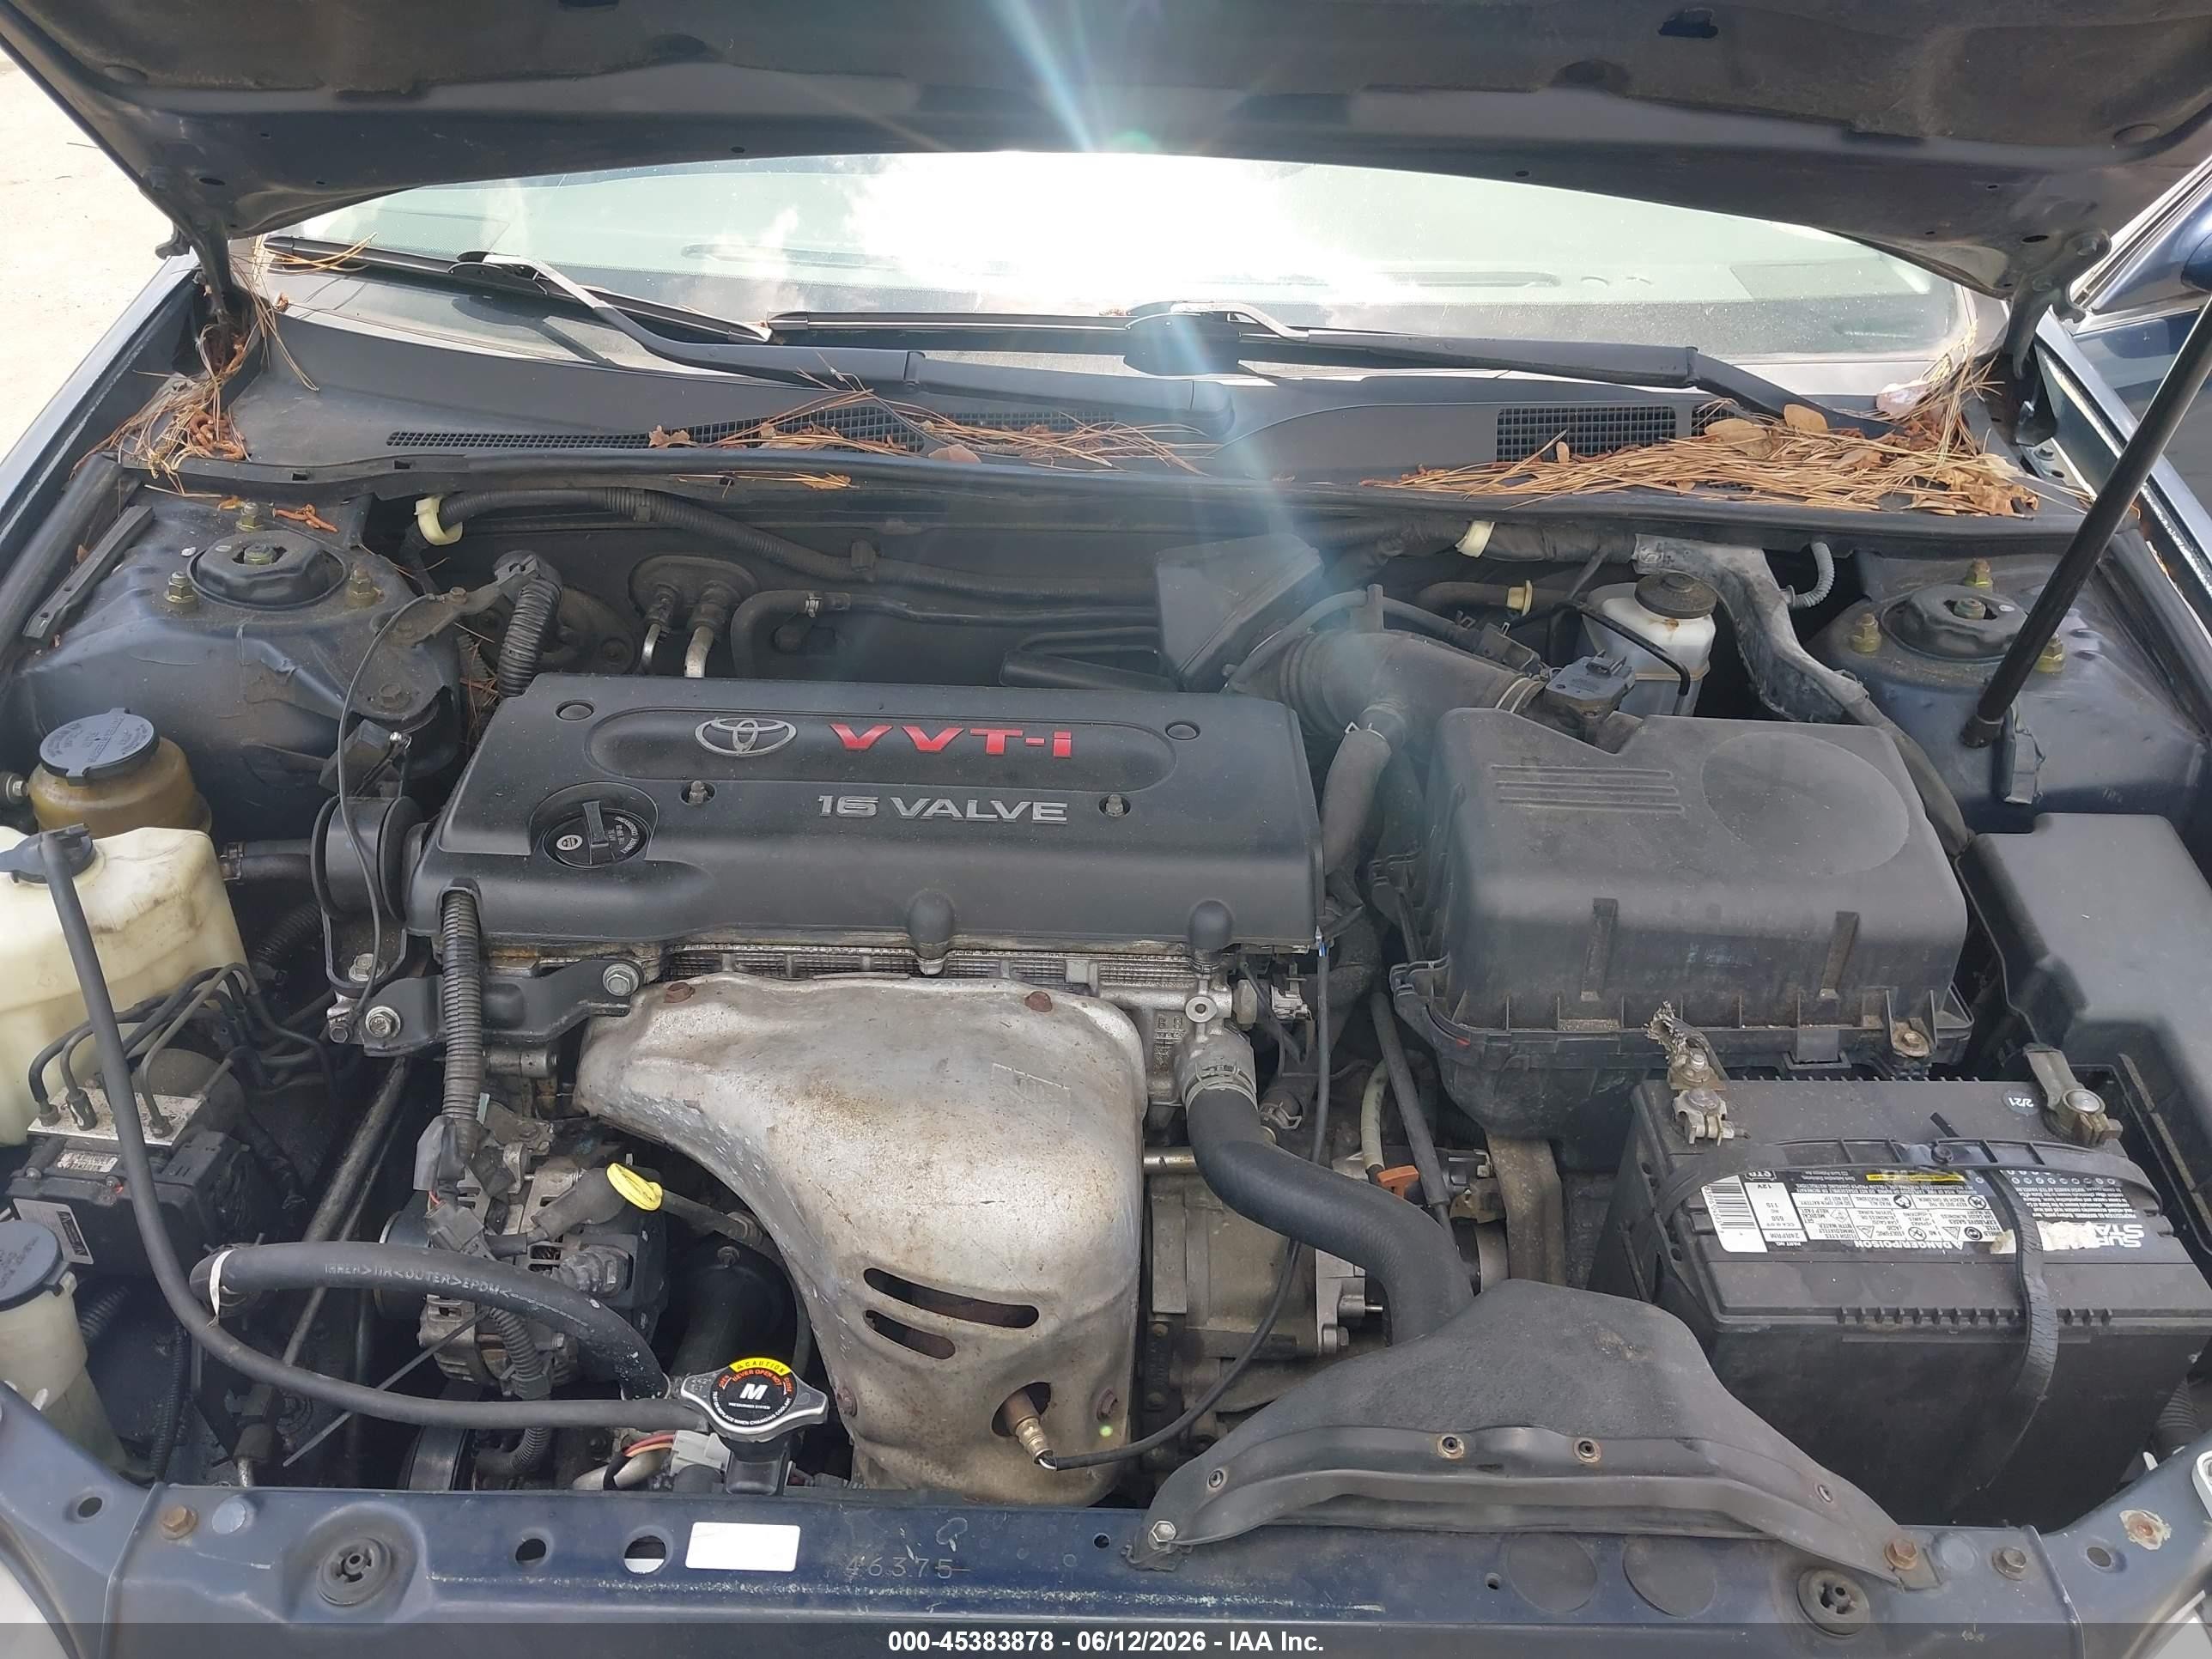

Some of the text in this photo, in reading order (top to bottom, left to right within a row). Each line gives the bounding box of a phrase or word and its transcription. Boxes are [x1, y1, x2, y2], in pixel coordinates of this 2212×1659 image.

[817, 795, 1069, 823] 16 VALVE
[2094, 1224, 2145, 1237] STA
[1853, 1239, 1953, 1249] DANGER/POISON
[745, 1360, 785, 1374] CAUTION
[732, 1369, 754, 1382] NEVER
[755, 1369, 772, 1378] OPEN
[739, 1382, 769, 1401] M
